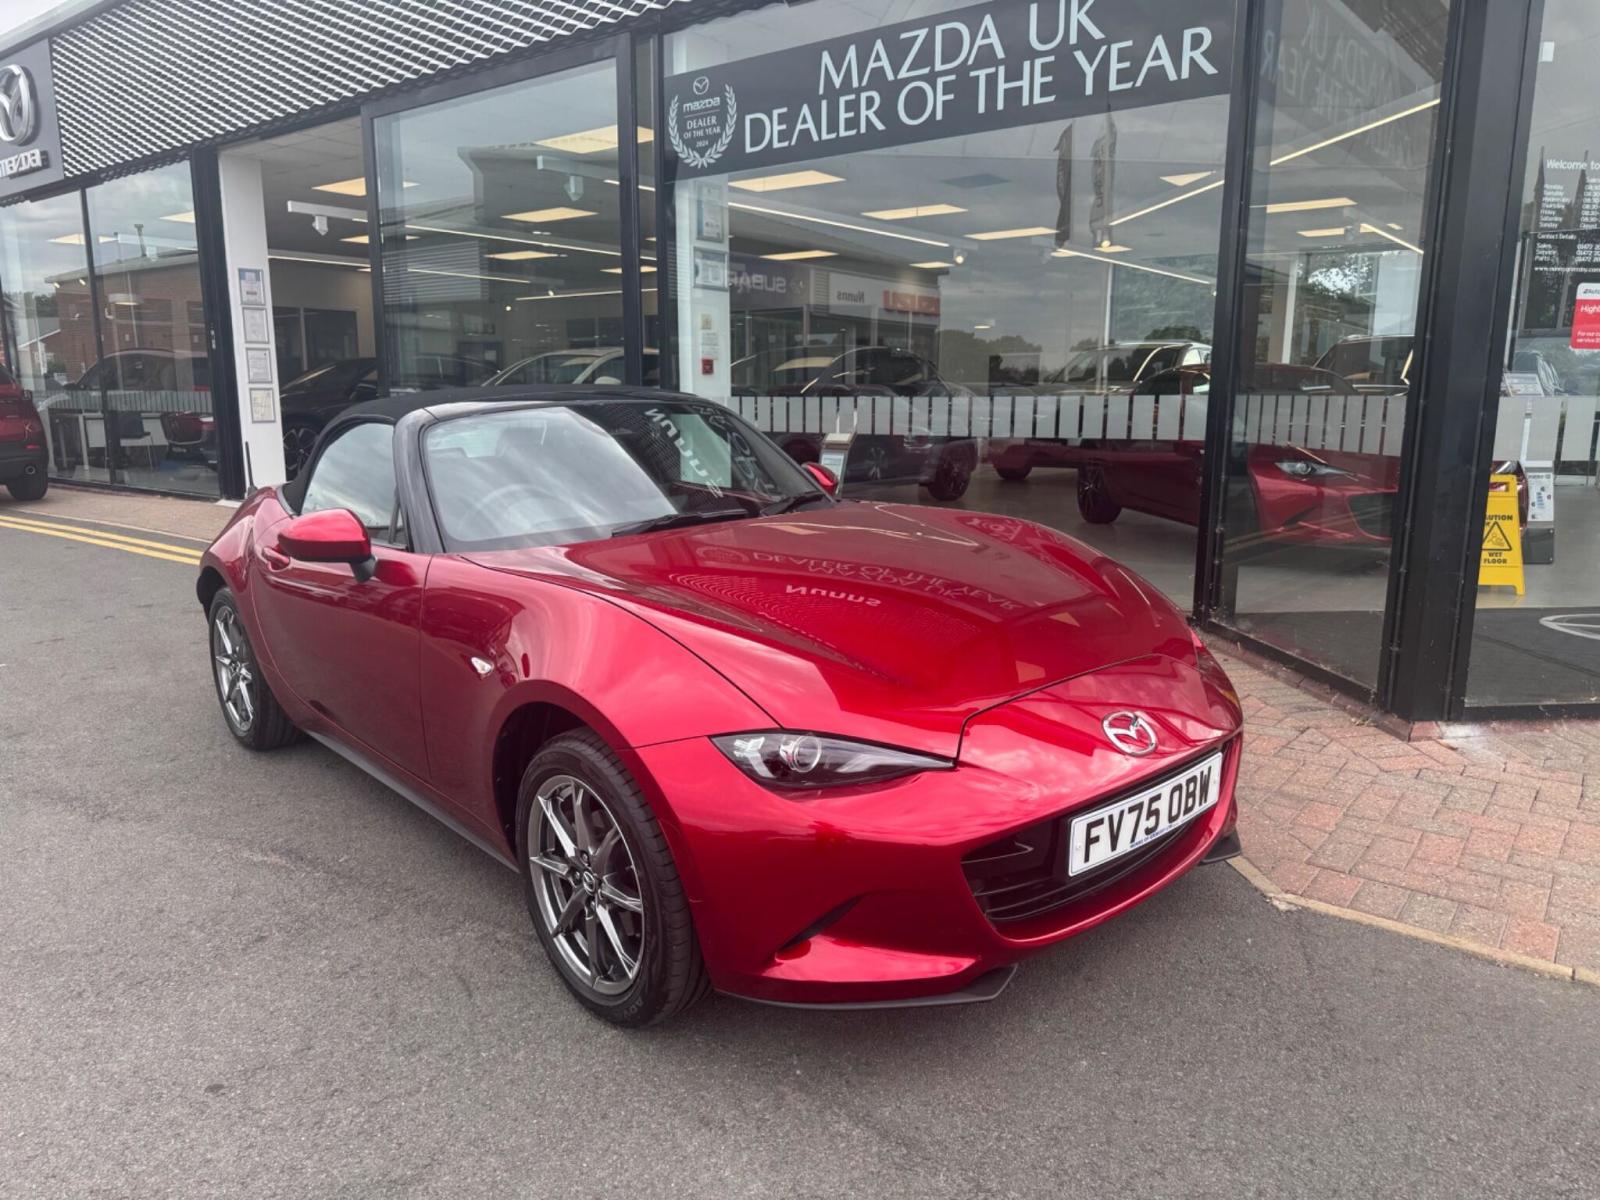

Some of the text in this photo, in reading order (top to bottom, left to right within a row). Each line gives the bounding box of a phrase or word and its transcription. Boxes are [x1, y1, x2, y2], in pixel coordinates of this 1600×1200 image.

[818, 0, 1106, 96] MAZDA UK
[745, 26, 1219, 154] DEALER OF THE YEAR
[683, 126, 721, 139] OF THE YEAR
[686, 115, 717, 130] DEALER
[1546, 159, 1588, 170] Welcome
[1084, 765, 1212, 864] FV75 OBW
